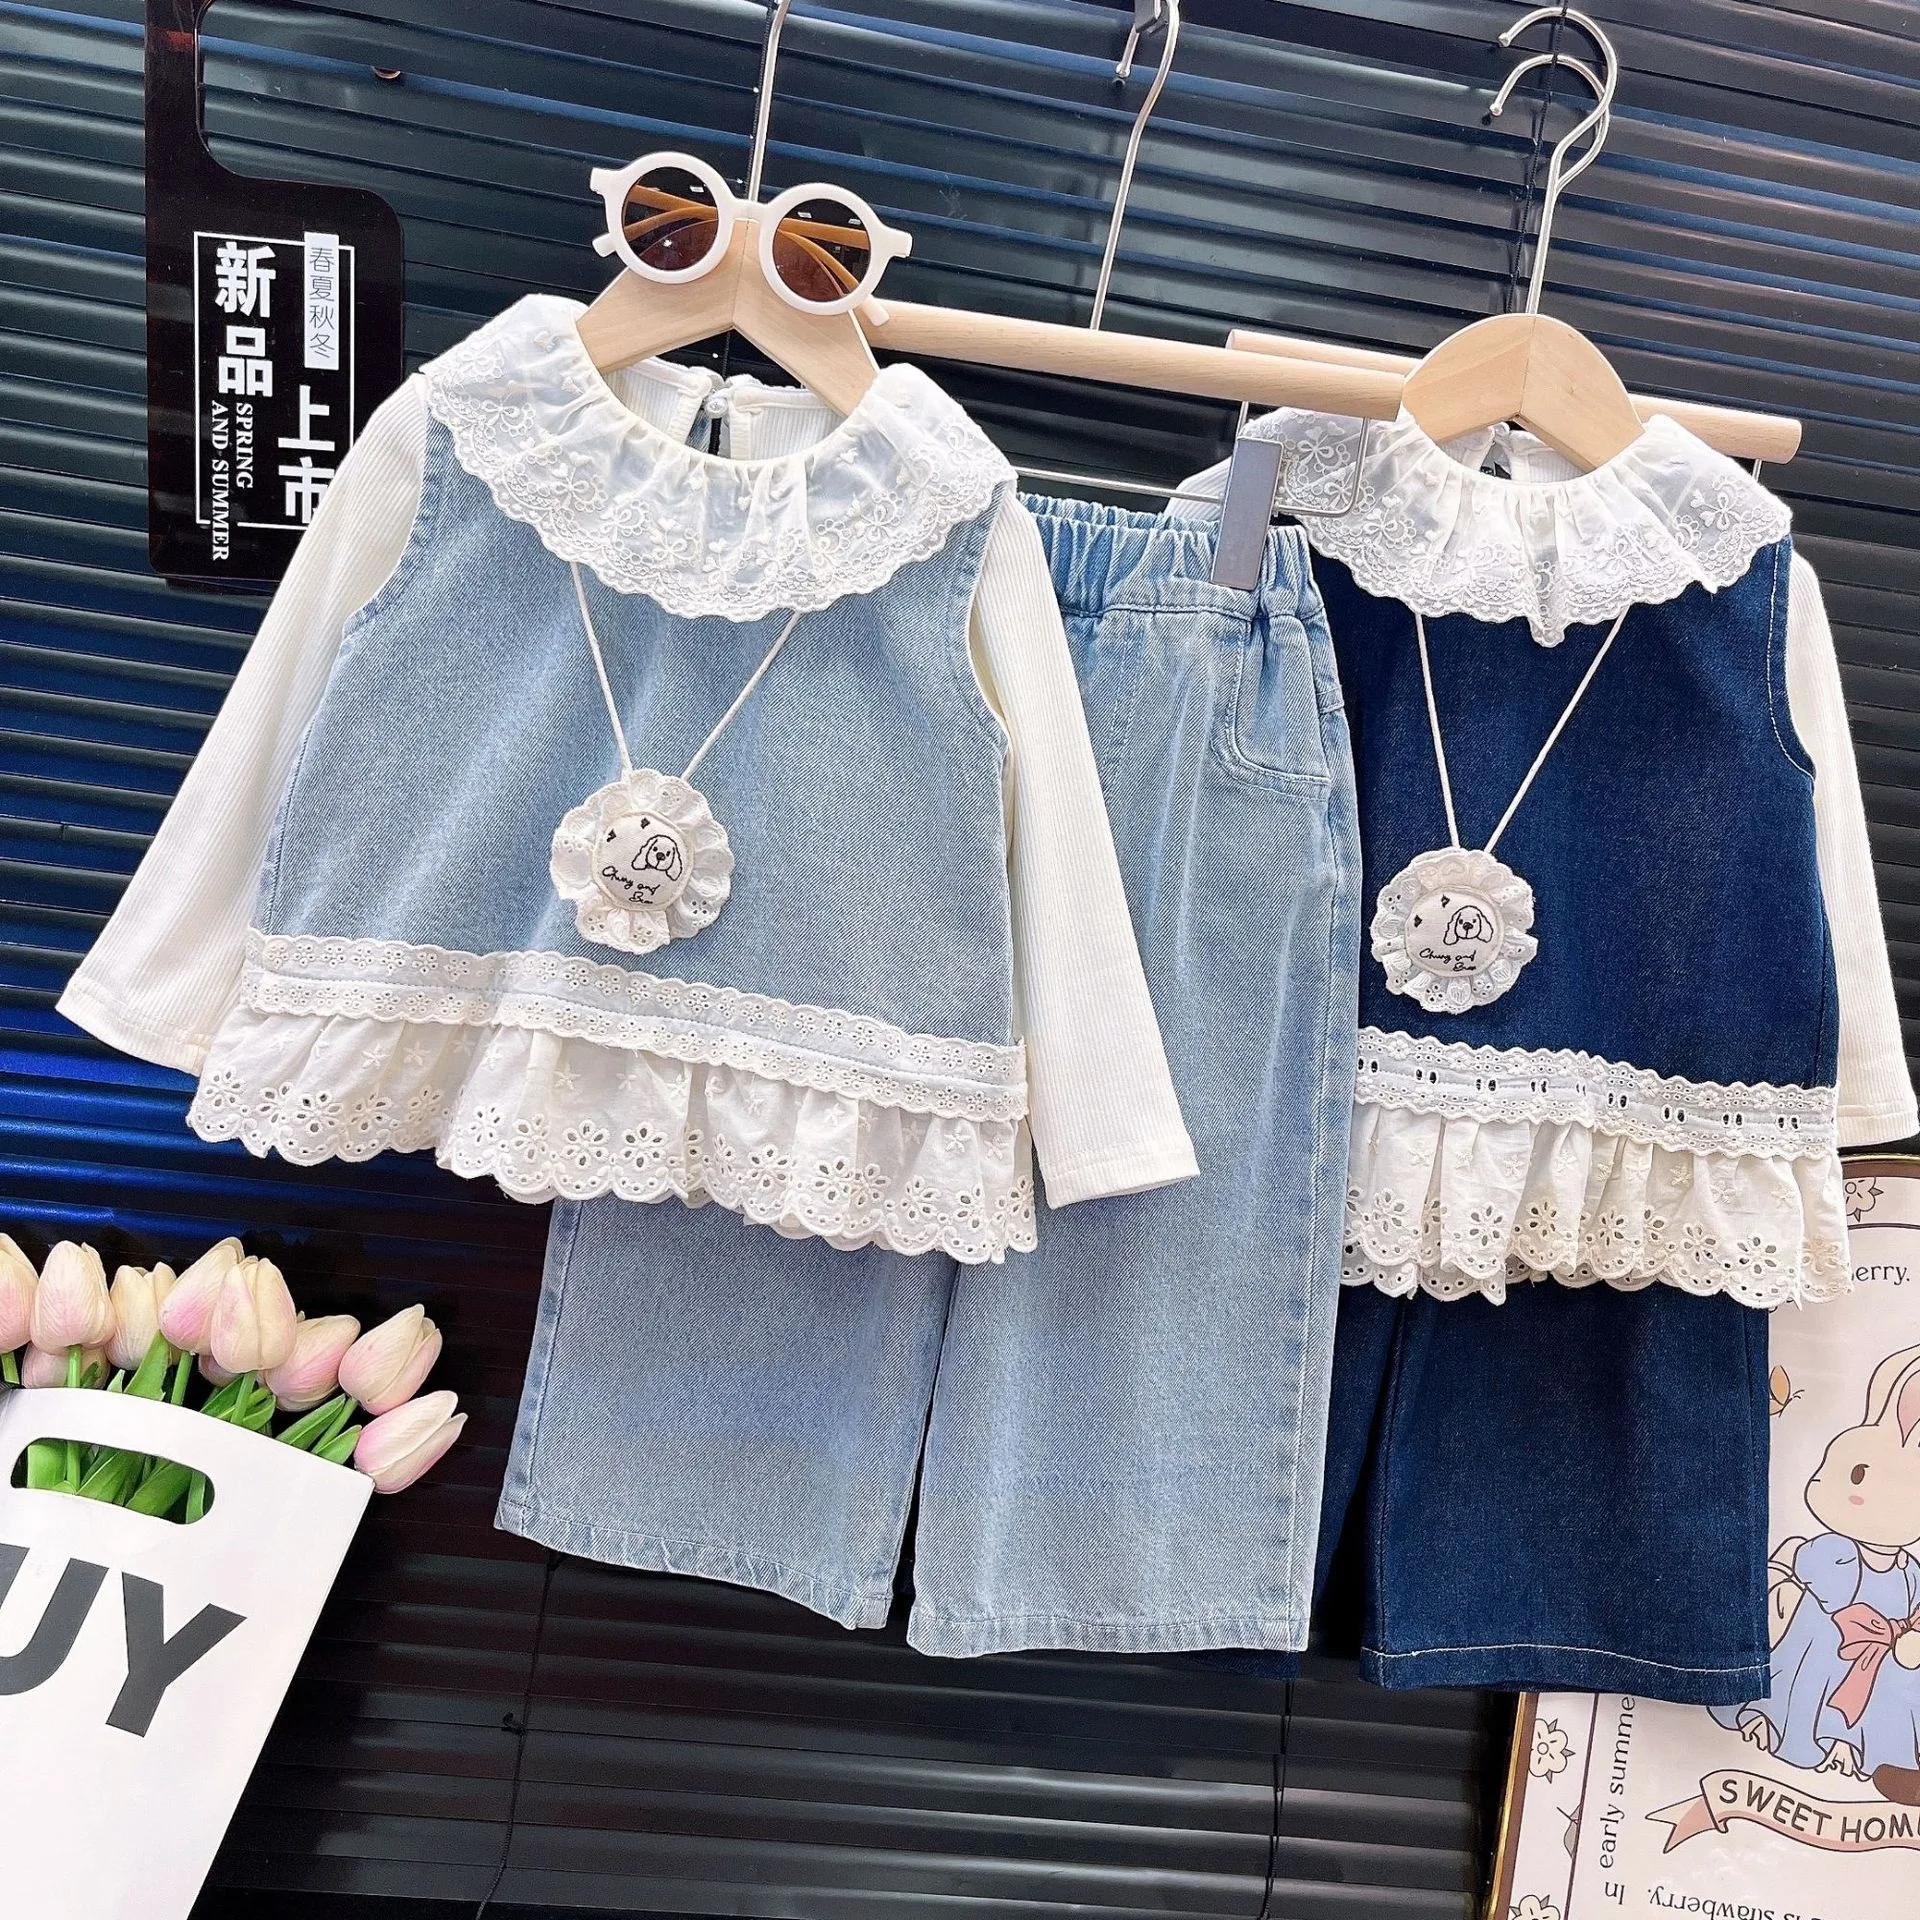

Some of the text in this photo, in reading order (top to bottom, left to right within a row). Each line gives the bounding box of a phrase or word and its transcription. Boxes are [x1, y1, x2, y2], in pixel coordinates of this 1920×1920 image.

[214, 241, 276, 397] 新品
[309, 247, 335, 358] 春夏秋冬
[211, 400, 230, 561] AND SUMMER
[236, 402, 254, 490] SPRING
[278, 385, 335, 524] 上市
[1851, 1266, 1910, 1286] erry.
[0, 1543, 248, 1738] UY
[1600, 1804, 1625, 1869] early
[1719, 1779, 1920, 1844] SWEET HOM
[1604, 1881, 1625, 1905] In
